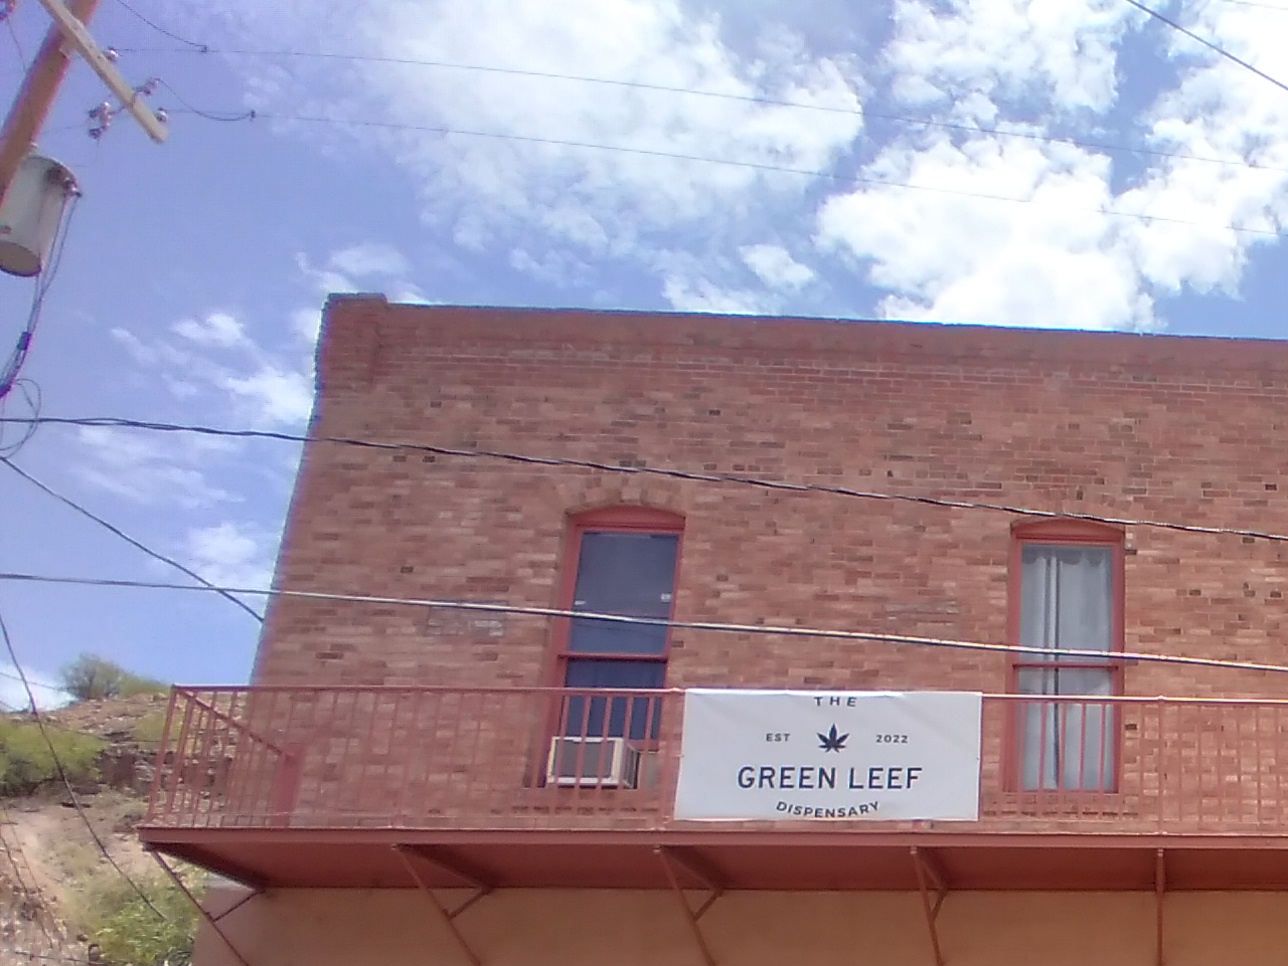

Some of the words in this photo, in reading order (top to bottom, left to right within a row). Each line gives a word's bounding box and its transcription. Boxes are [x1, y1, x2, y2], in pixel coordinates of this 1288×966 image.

[814, 695, 858, 708] THE
[765, 732, 791, 743] EST
[875, 733, 909, 744] 2022
[737, 766, 836, 790] GREEN
[848, 767, 923, 790] LEEF
[775, 801, 881, 819] DISPENSARY
